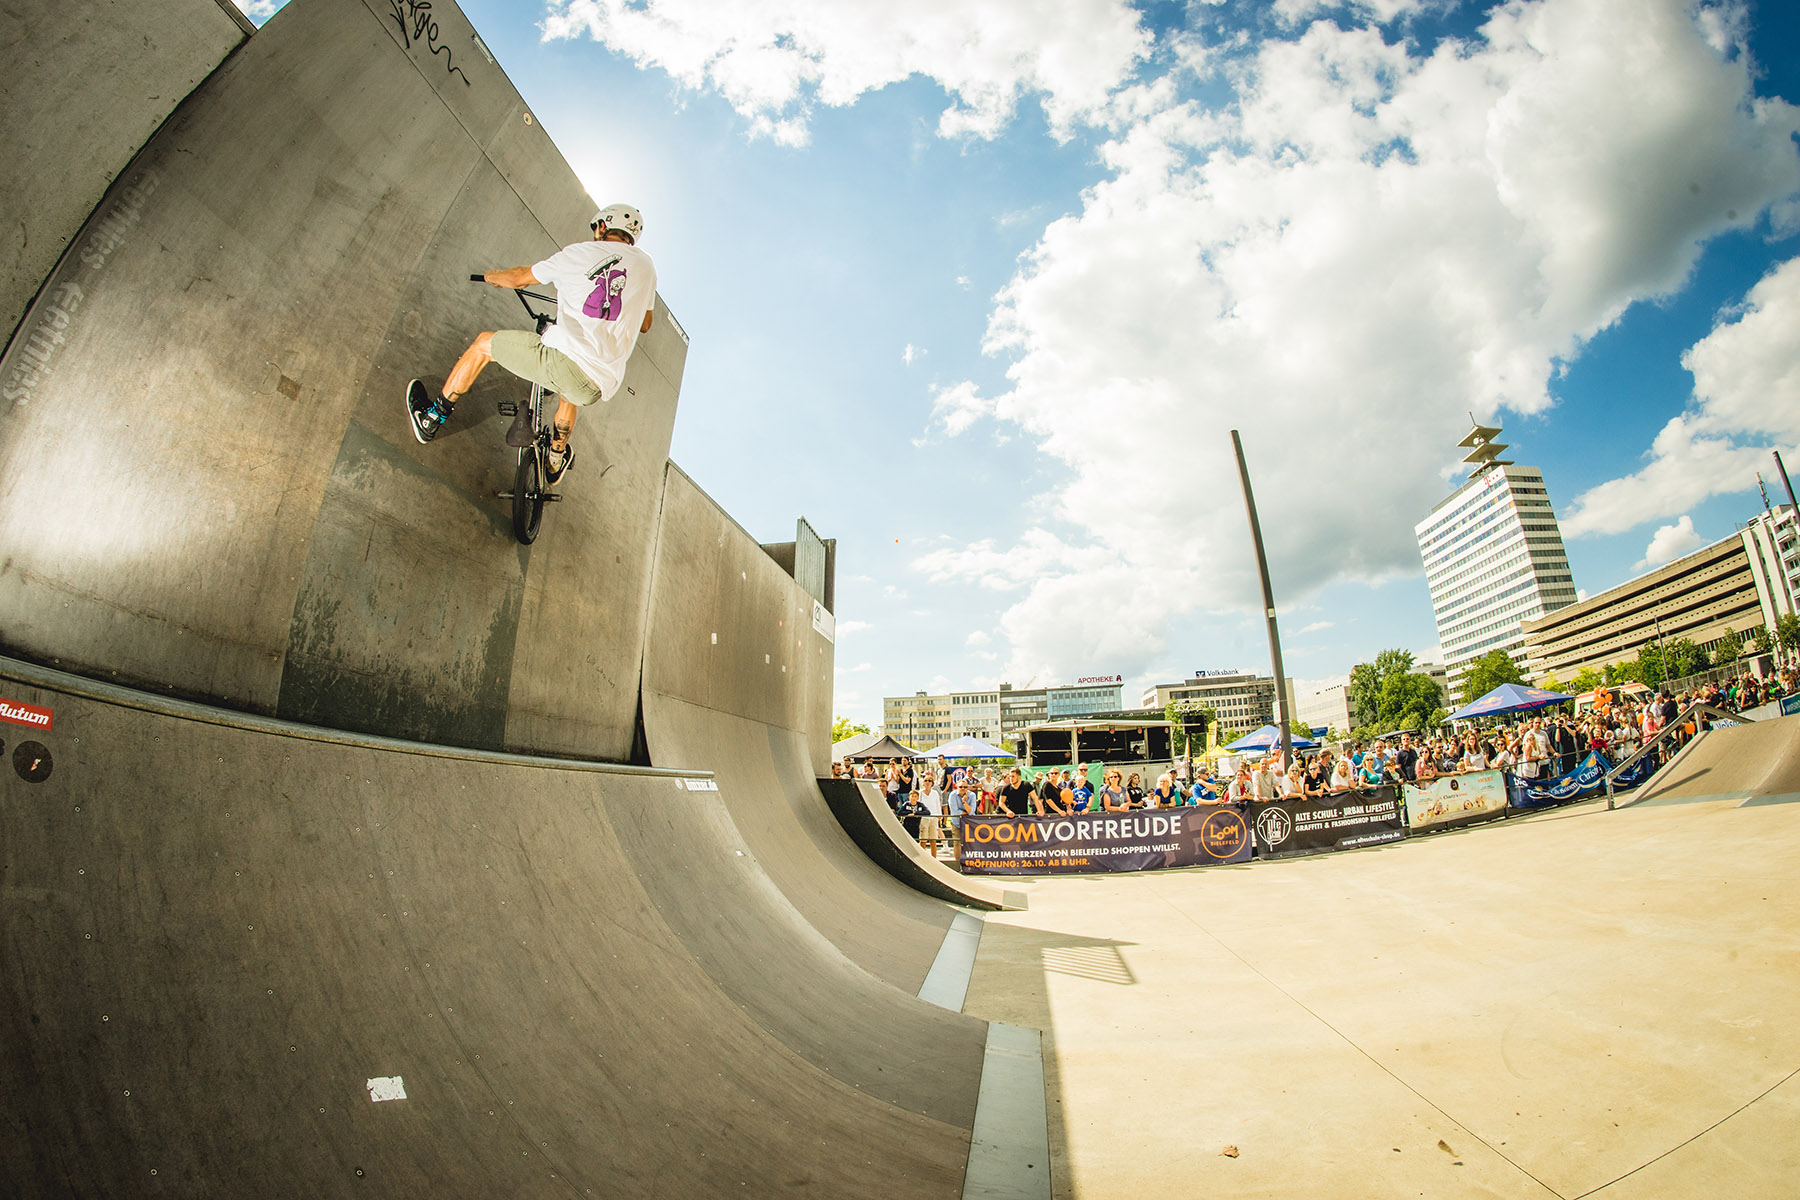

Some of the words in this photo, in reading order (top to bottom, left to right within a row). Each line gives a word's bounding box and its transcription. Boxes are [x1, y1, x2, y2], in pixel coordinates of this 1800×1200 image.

[1077, 675, 1114, 684] APOTHEKE
[1206, 668, 1240, 677] Volksbank
[0, 703, 49, 725] Autum
[1295, 811, 1311, 822] ALTE
[1312, 808, 1338, 820] SCHULE
[1343, 805, 1365, 816] URBAN
[1365, 801, 1395, 813] LIFESTYLE
[965, 815, 1181, 843] LOOMVORFREUDE
[1295, 822, 1323, 832] GRAFFITI
[1324, 821, 1330, 829] &
[1331, 816, 1370, 828] FASHIONSHOP
[1369, 812, 1397, 823] BIELEFELD
[1210, 824, 1239, 840] LOOM
[965, 850, 985, 858] WEIL
[1001, 850, 1012, 858] IM
[1013, 850, 1046, 858] HERZEN
[1048, 849, 1068, 857] VON
[1070, 847, 1109, 856] BIELEFELD
[1111, 845, 1150, 855] SHOPPEN
[1152, 843, 1181, 852] WILLST.
[1210, 839, 1240, 847] BIELEFELD
[965, 859, 1020, 868] ERÖFFNUNG:
[1021, 859, 1046, 867] 26.10.
[1048, 859, 1060, 867] AB
[1069, 858, 1090, 866] UHR.
